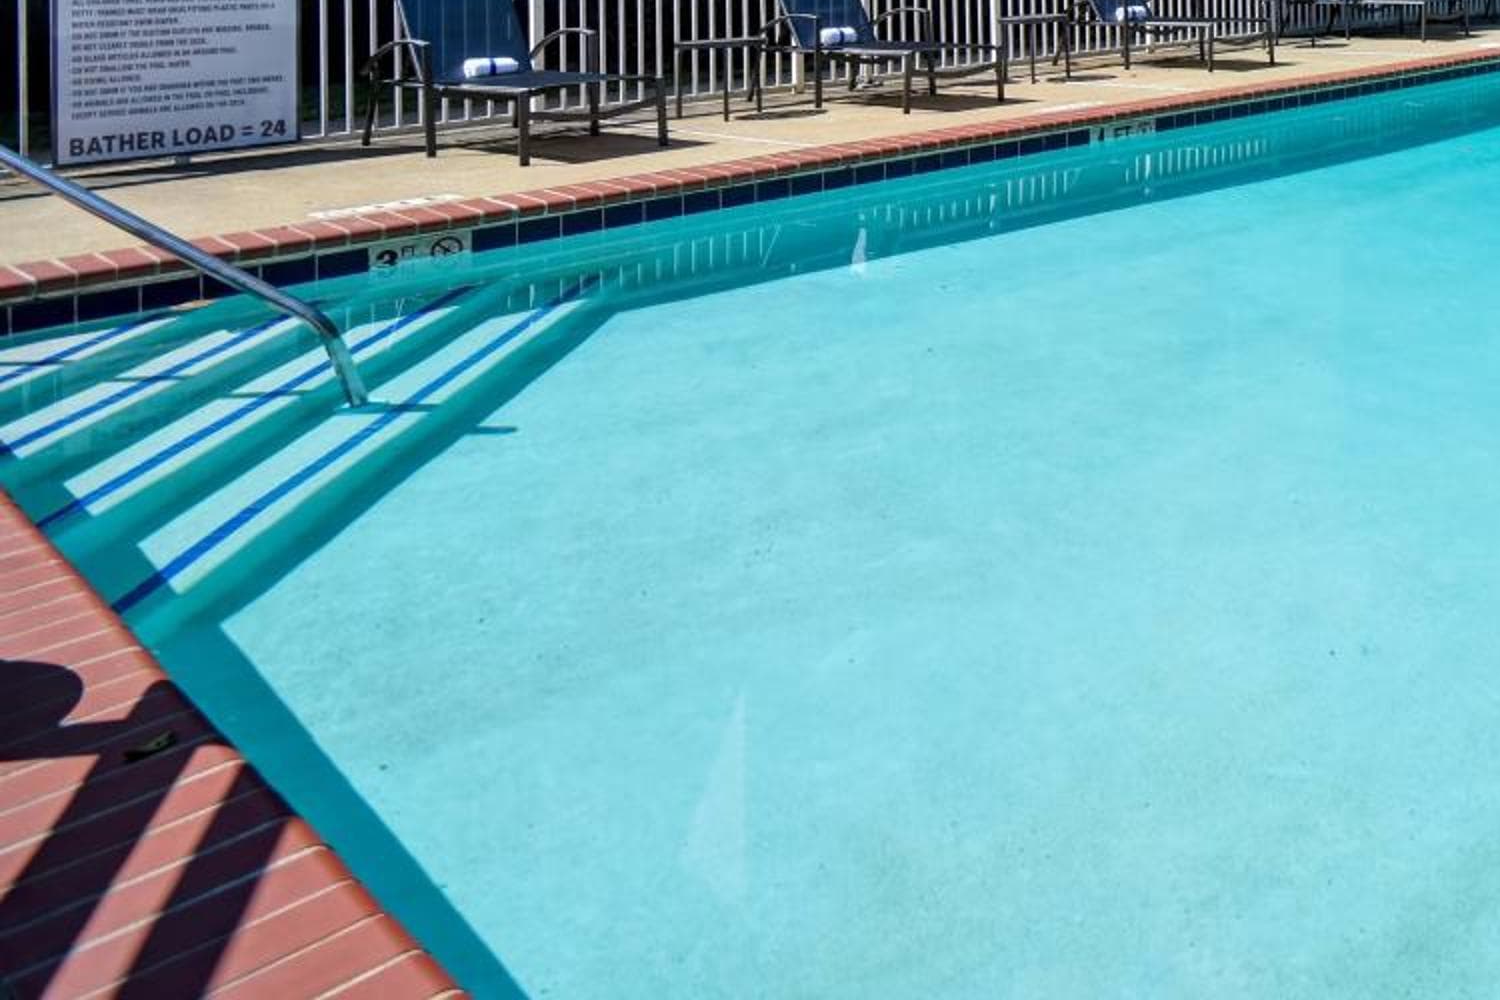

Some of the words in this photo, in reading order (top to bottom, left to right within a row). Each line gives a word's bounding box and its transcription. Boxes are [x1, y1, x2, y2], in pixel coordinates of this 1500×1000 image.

[69, 131, 165, 157] BATHER
[173, 124, 235, 147] LOAD
[260, 119, 287, 138] 24
